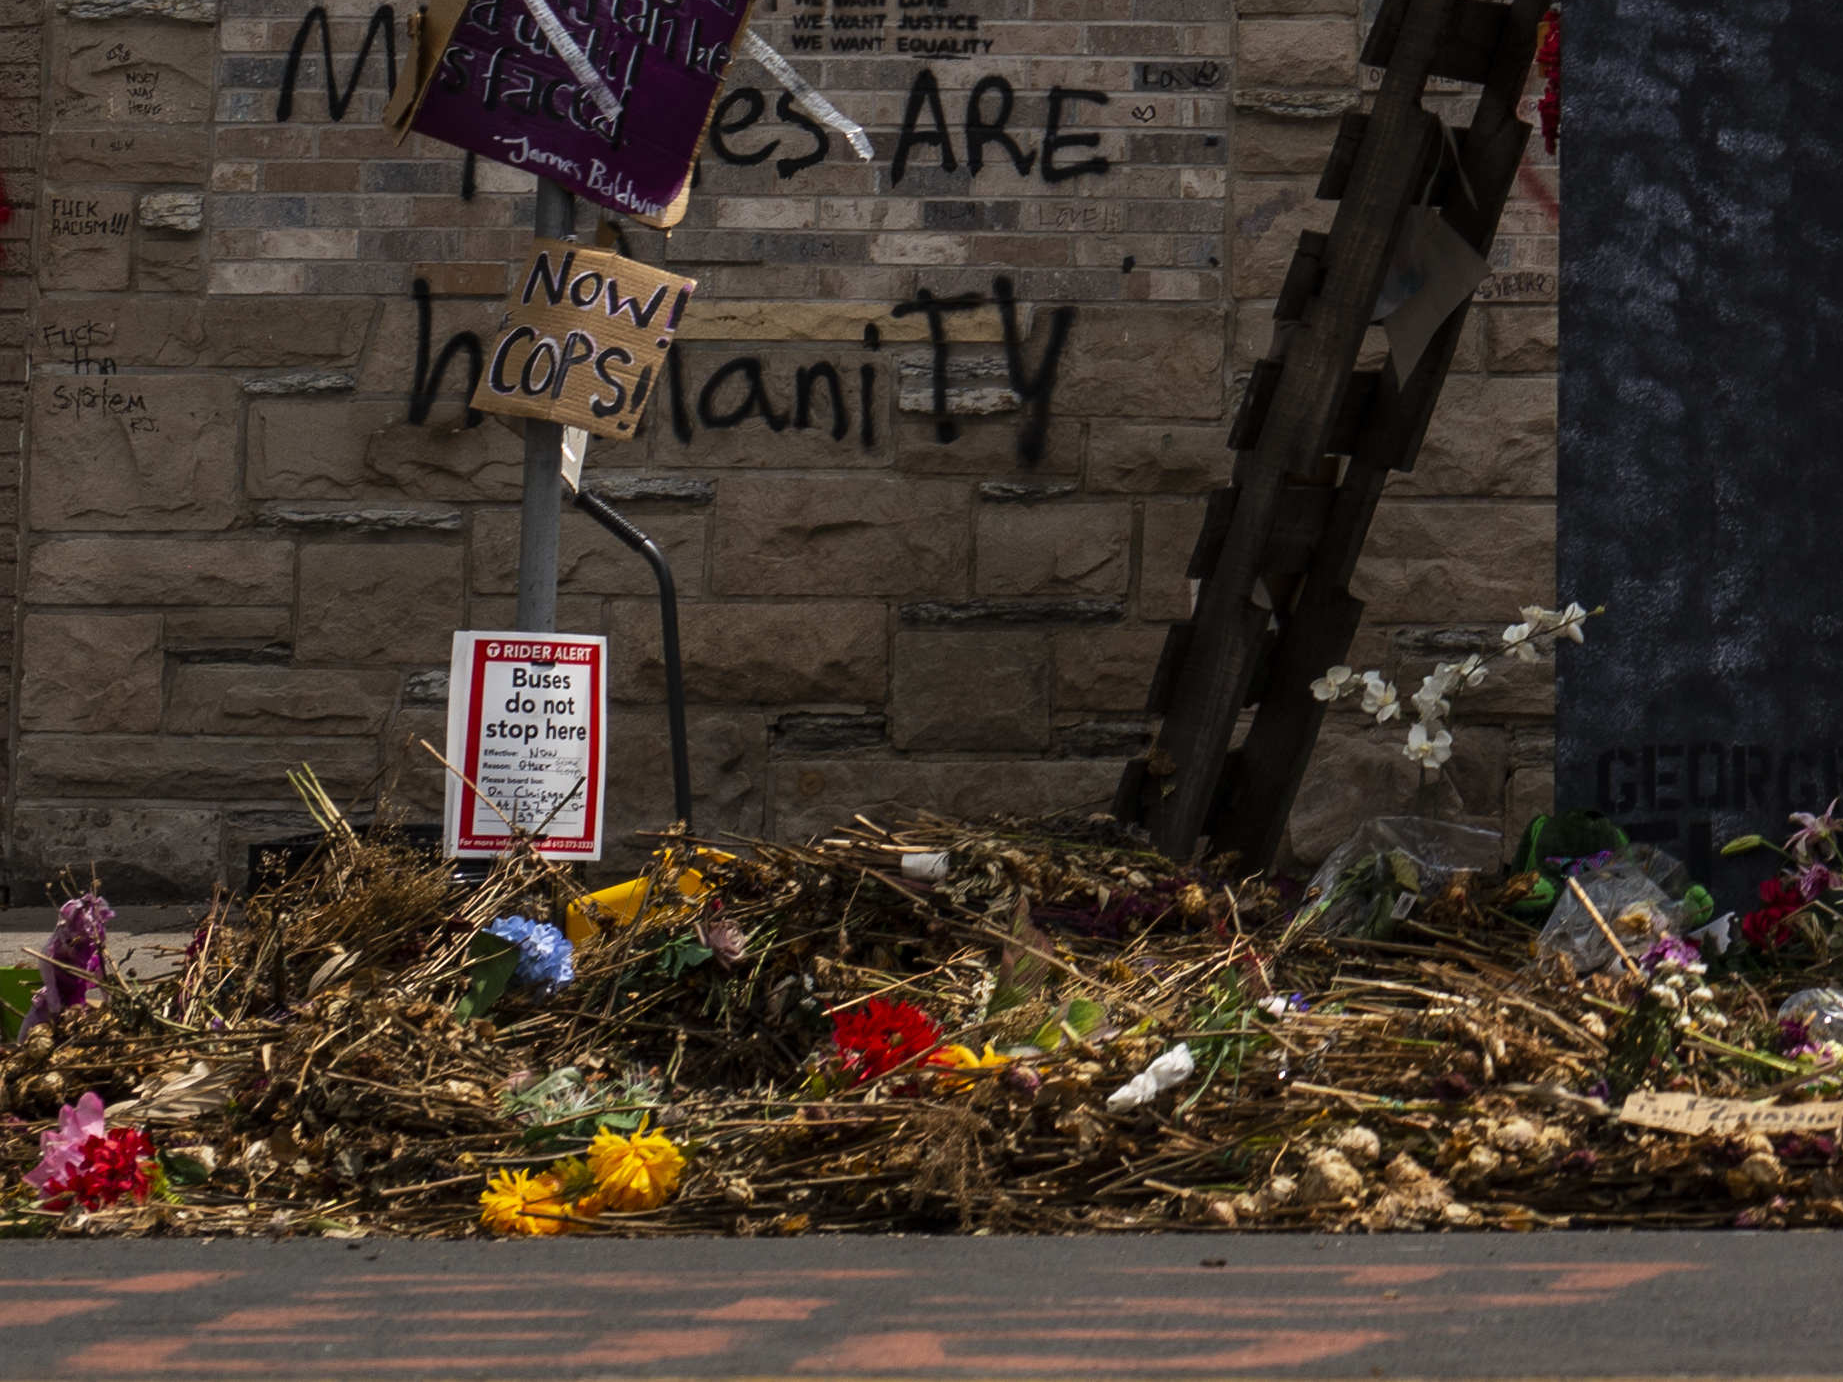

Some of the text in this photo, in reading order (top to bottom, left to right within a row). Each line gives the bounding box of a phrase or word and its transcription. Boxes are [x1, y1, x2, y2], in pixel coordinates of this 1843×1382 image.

[793, 13, 980, 30] WE WANT JUSTICE
[686, 17, 733, 82] be
[793, 35, 994, 54] WE WANT EQUALITY
[127, 89, 154, 100] WAS
[893, 68, 1107, 188] ARE
[586, 157, 665, 216] Baldwin
[52, 199, 99, 218] FUCK
[488, 325, 653, 431] COPS!
[503, 643, 592, 662] RIDER ALERT
[512, 667, 571, 690] Buses
[505, 691, 575, 715] do not
[485, 718, 587, 745] stop here
